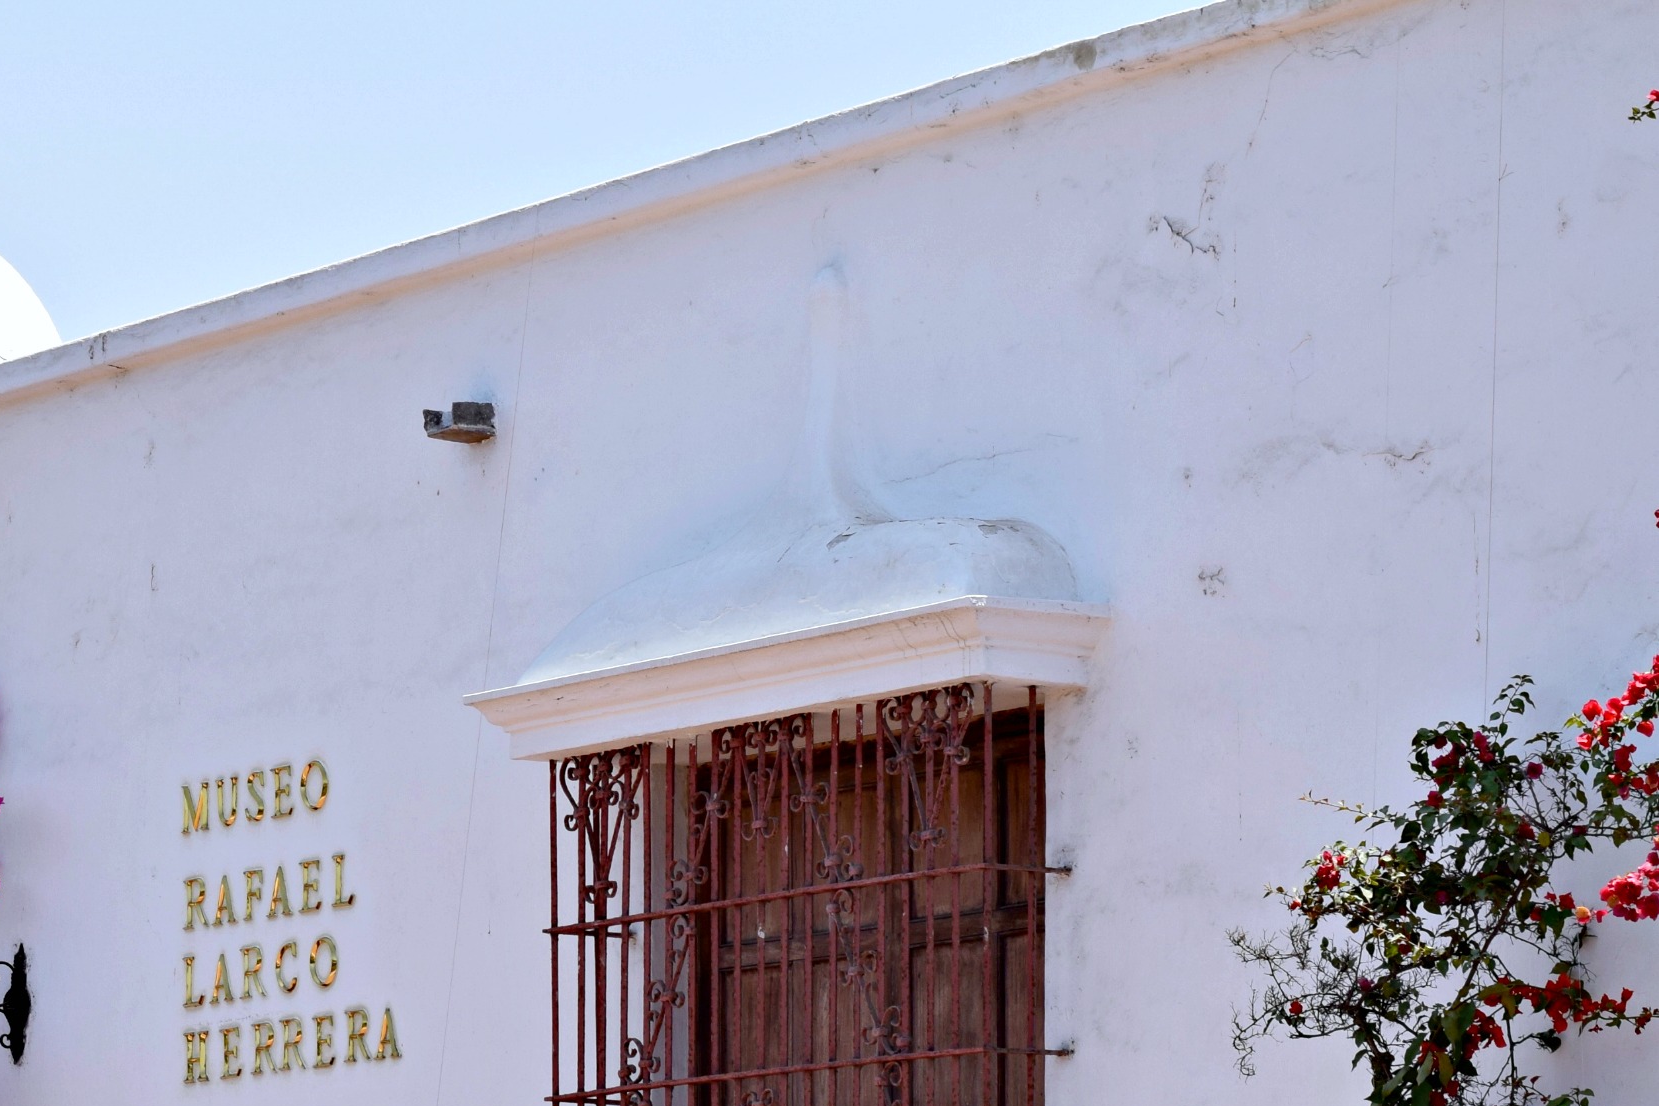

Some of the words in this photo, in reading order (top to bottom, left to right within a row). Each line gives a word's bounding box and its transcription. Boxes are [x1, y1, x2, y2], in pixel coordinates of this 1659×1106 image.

[181, 760, 329, 834] MUSEO
[183, 854, 355, 930] RAFAEL
[183, 936, 338, 1008] LARCO
[183, 1007, 402, 1084] HERRERA
